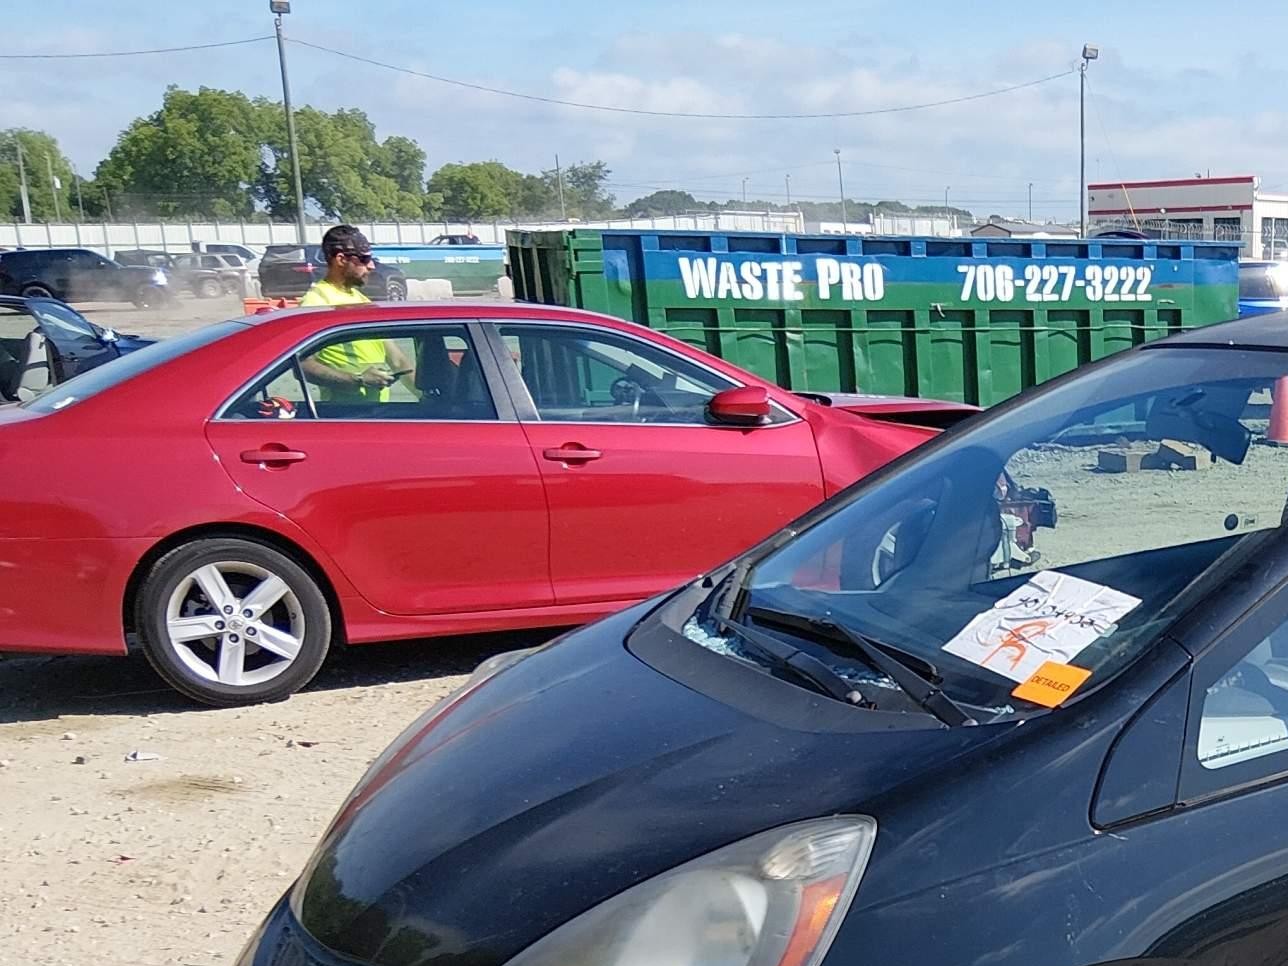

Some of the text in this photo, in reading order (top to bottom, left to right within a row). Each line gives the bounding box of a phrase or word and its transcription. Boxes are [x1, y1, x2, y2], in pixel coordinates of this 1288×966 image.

[678, 257, 1152, 301] WASTE PRO 706-227-3222
[1031, 674, 1070, 692] DETAILED
